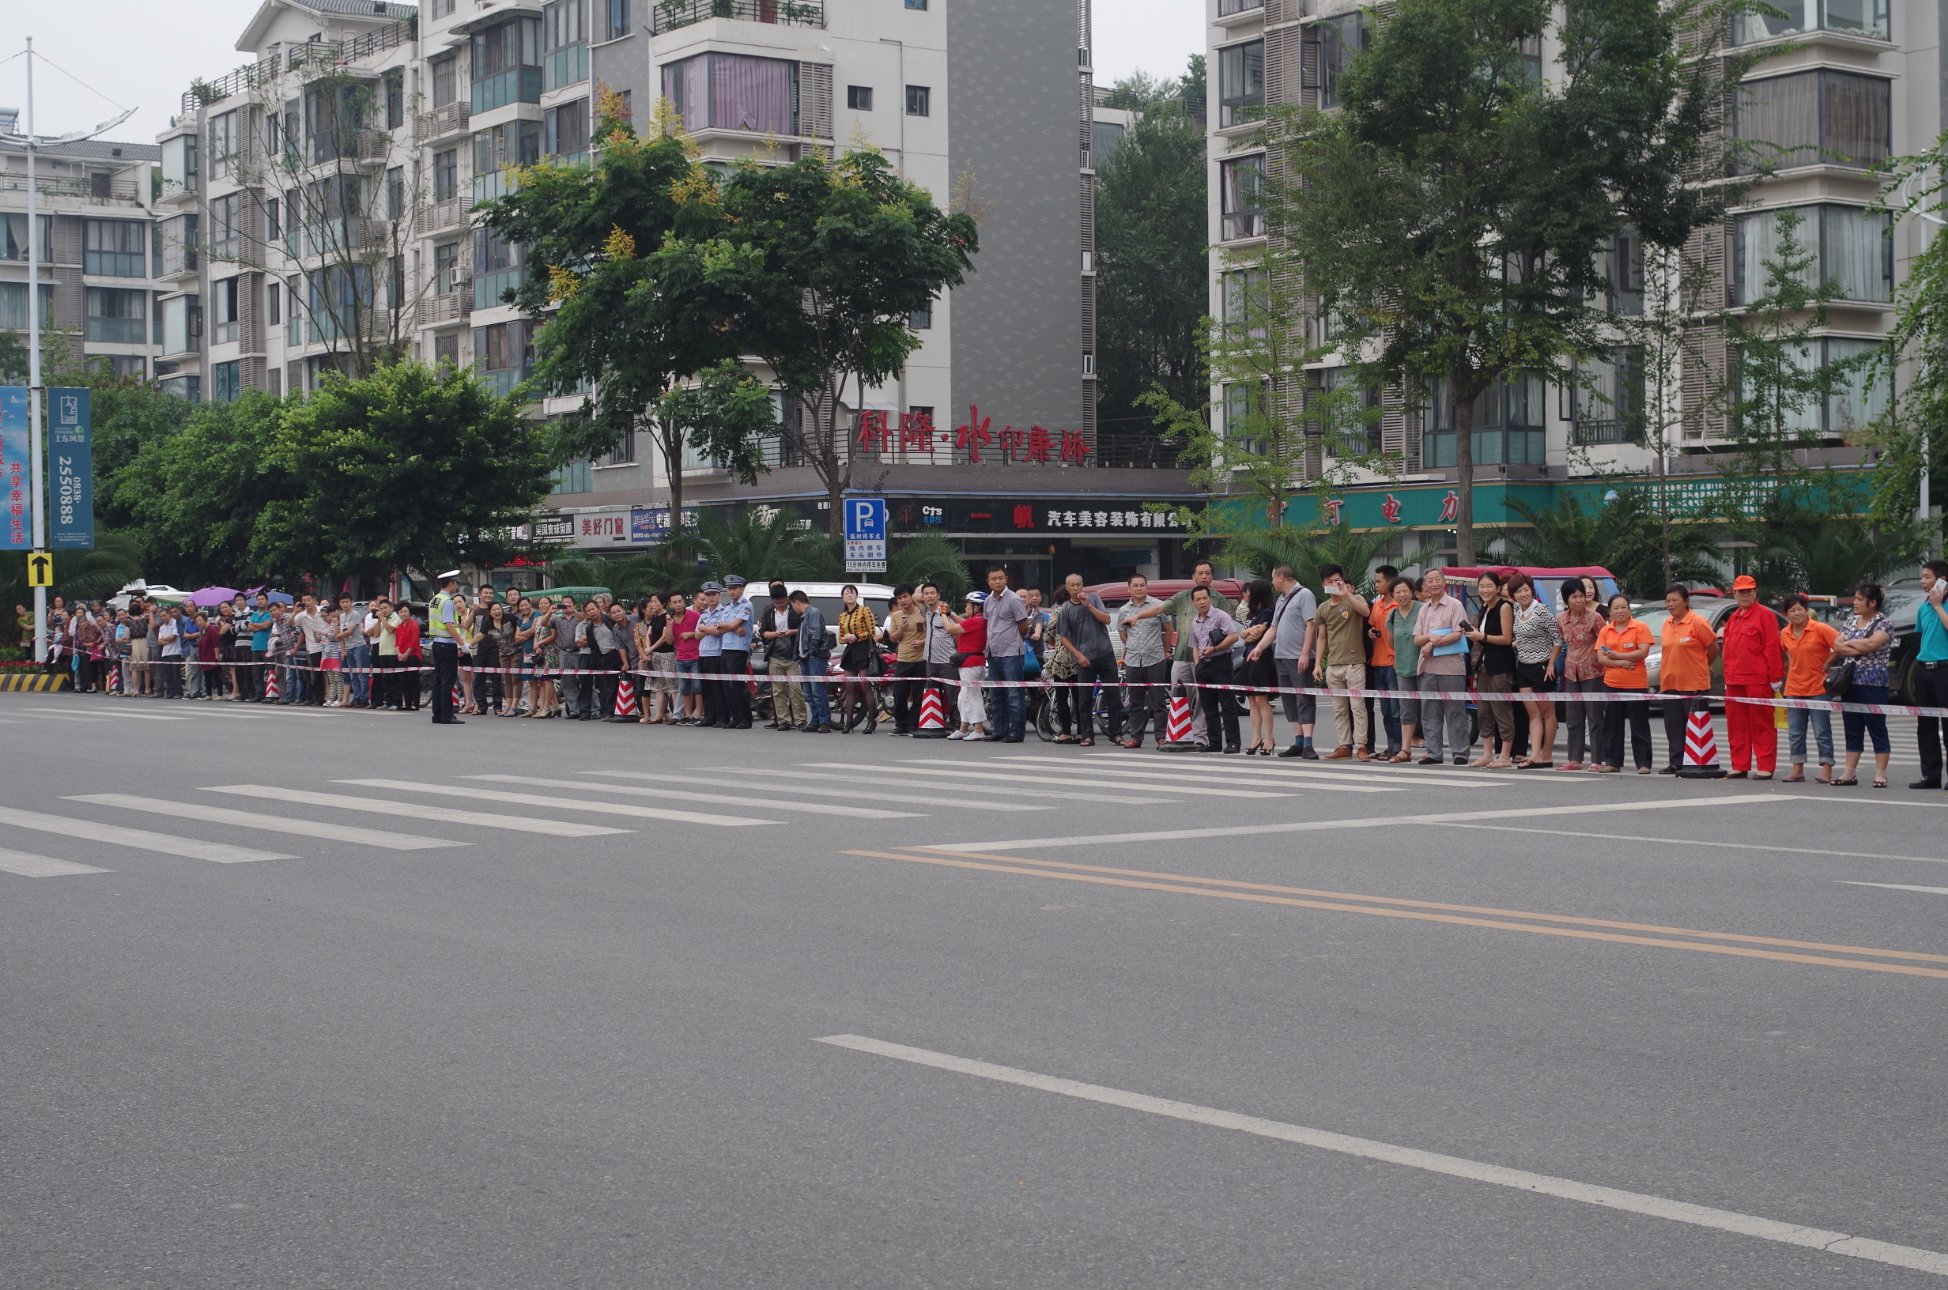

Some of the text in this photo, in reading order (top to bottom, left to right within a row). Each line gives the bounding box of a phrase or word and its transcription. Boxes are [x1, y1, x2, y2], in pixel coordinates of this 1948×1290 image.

[10, 462, 24, 545] 共享幸福生活
[58, 456, 73, 525] 2550888
[582, 516, 624, 536] 美好门窗
[856, 502, 874, 533] P
